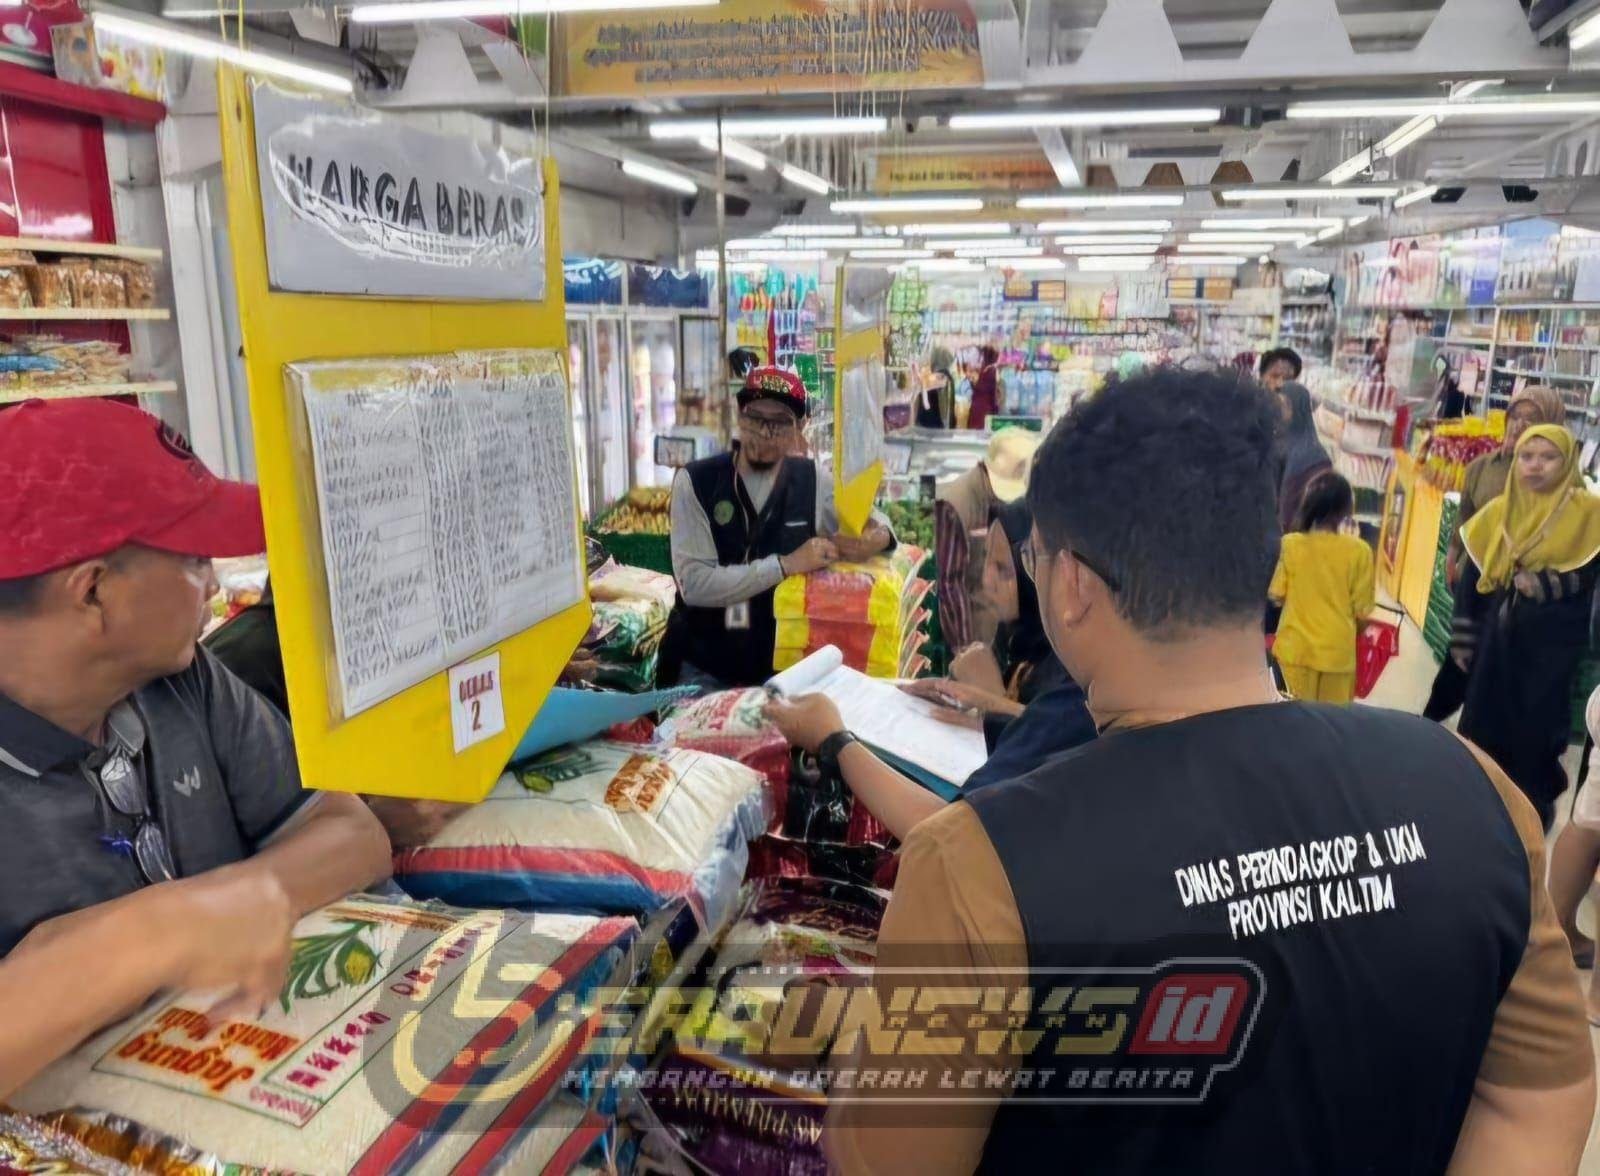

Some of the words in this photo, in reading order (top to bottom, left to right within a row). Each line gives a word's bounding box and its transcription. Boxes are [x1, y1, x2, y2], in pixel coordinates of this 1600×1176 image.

[472, 700, 482, 731] 2
[1175, 859, 1234, 908] DINAS
[1384, 822, 1427, 866] UKM
[1228, 886, 1315, 941] PROVINSI
[1319, 873, 1396, 921] KALTIM
